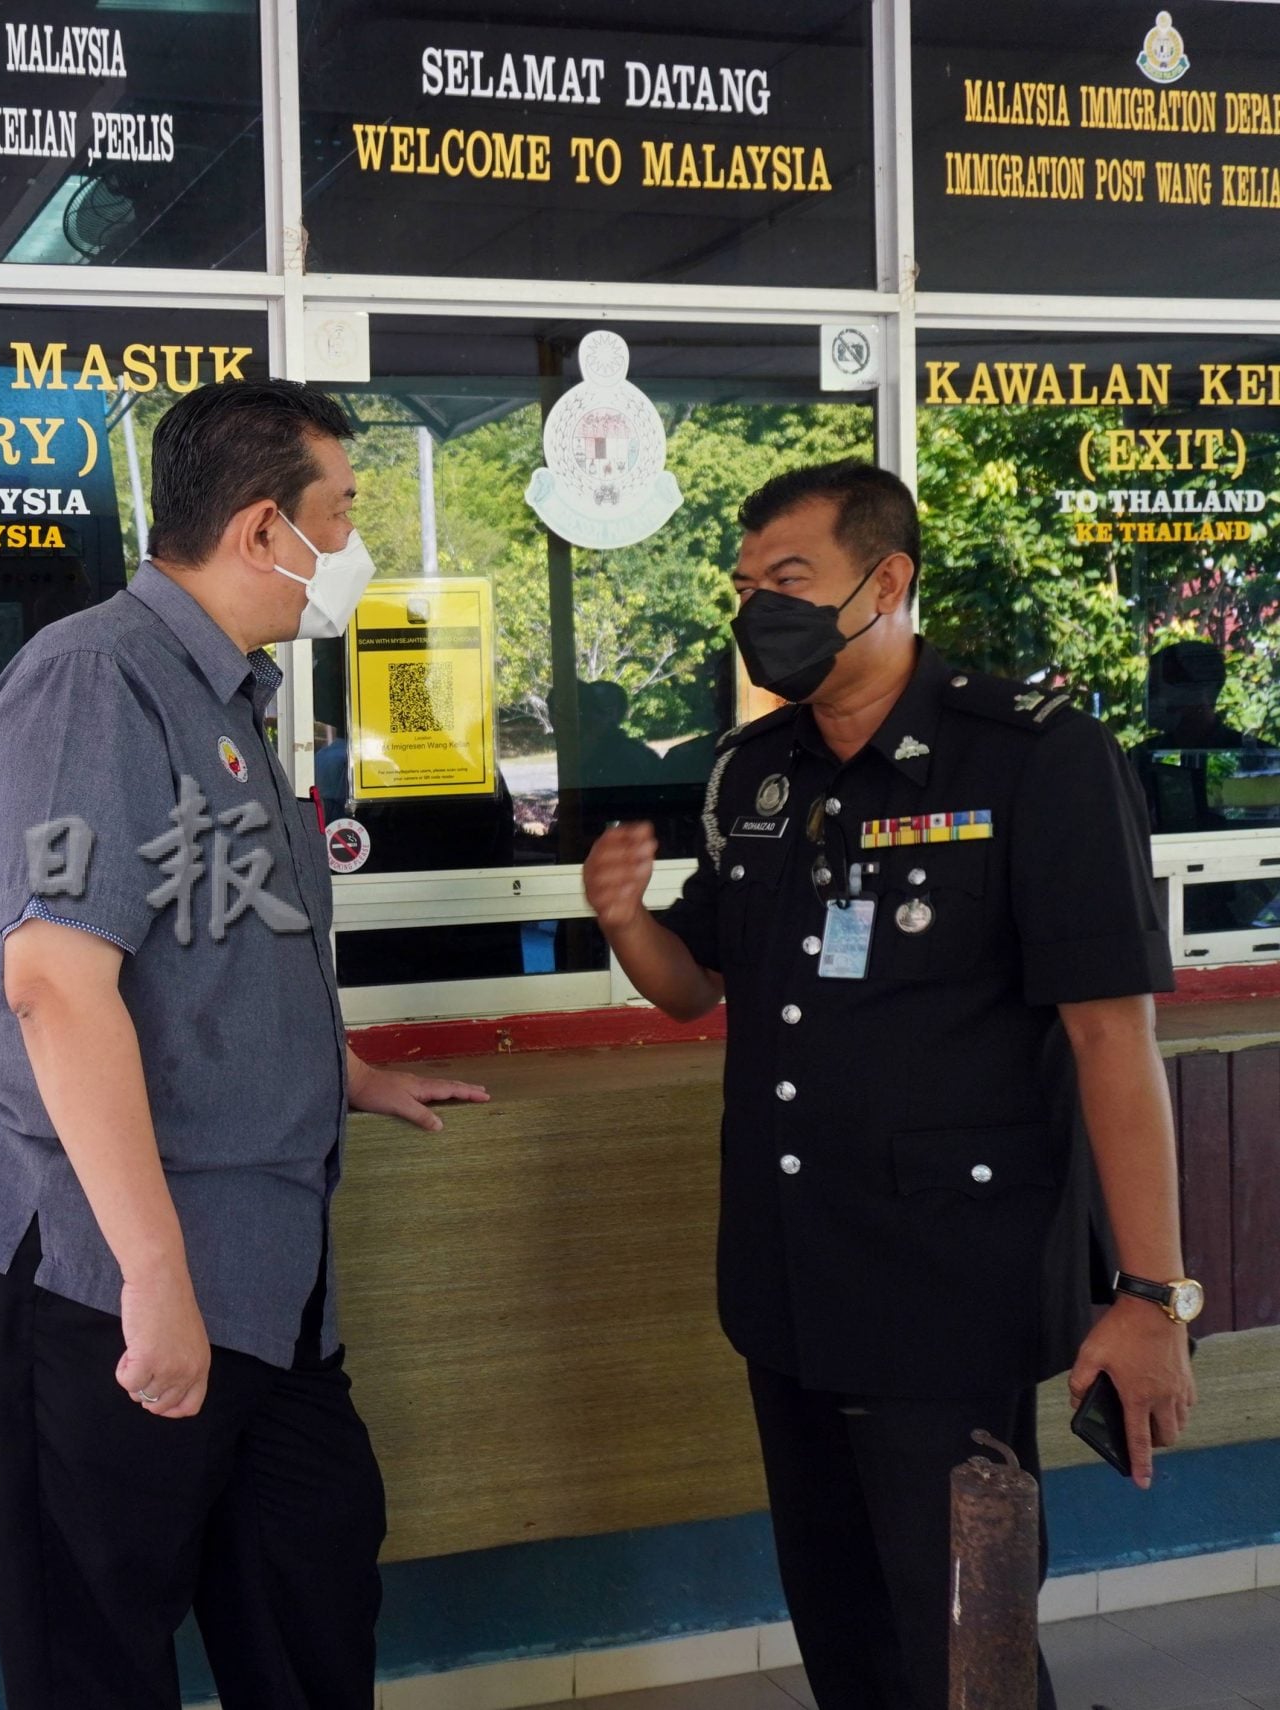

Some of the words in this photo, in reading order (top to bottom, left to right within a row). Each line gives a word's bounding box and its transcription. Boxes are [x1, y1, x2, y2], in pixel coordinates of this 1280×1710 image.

[5, 23, 127, 77] MALAYSIA
[421, 47, 604, 105] SELAMAT
[625, 61, 771, 116] DATANG
[964, 79, 1070, 127] MALAYSIA
[1080, 85, 1217, 133] IMMIGRATION
[352, 123, 551, 181] WELCOME
[571, 137, 622, 186] TO
[642, 141, 832, 191] MALAYSIA
[945, 152, 1085, 200] IMMIGRATION
[1095, 159, 1146, 202] POST
[1155, 162, 1212, 205] WANG
[10, 342, 253, 393] MASUK
[925, 361, 1172, 405] KAWALAN
[1079, 428, 1247, 482] (EXIT)
[1055, 489, 1098, 513] TO
[1108, 489, 1266, 513] THAILAND
[1076, 522, 1114, 543] KE
[1119, 521, 1252, 542] THAILAND
[391, 743, 426, 752] Imigresen
[427, 742, 448, 751] Wang
